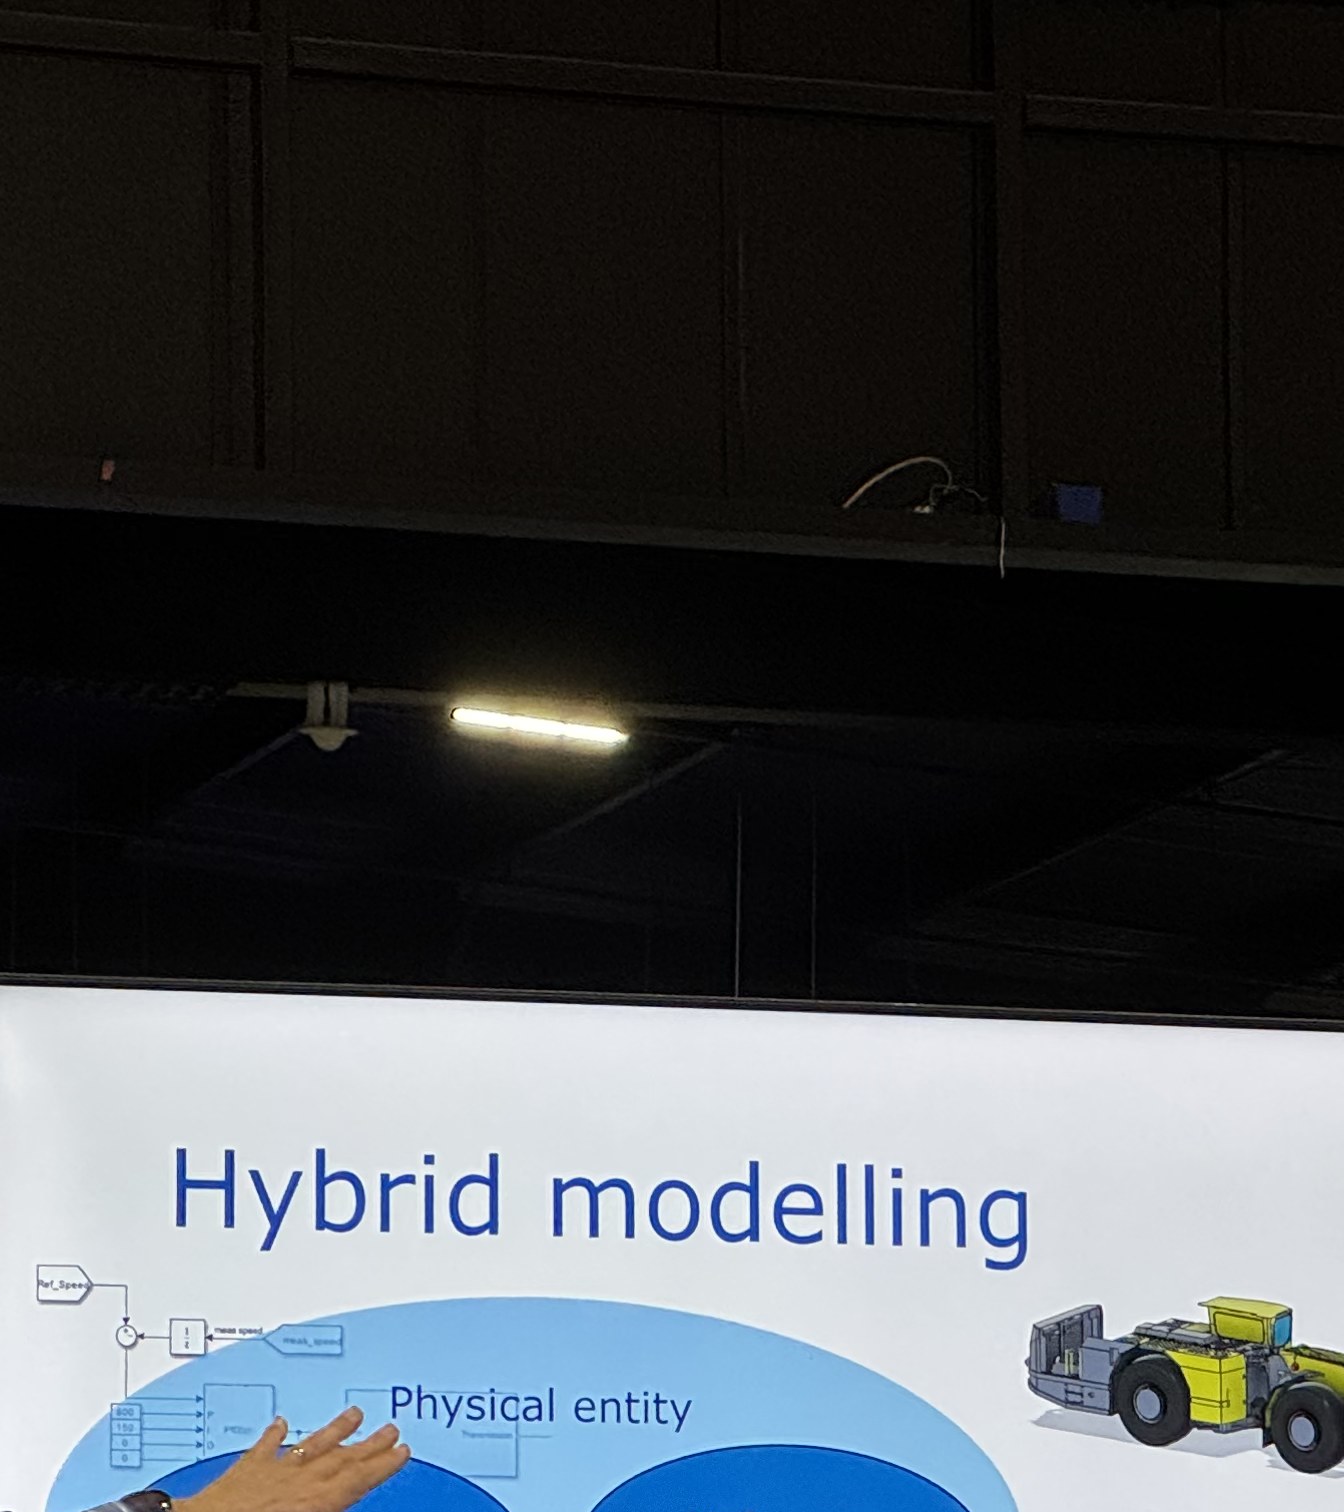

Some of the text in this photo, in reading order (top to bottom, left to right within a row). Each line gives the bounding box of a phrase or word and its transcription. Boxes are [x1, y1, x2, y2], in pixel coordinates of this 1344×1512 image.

[176, 1147, 1028, 1271] Hybrid modelling
[391, 1385, 693, 1433] Physical entity
